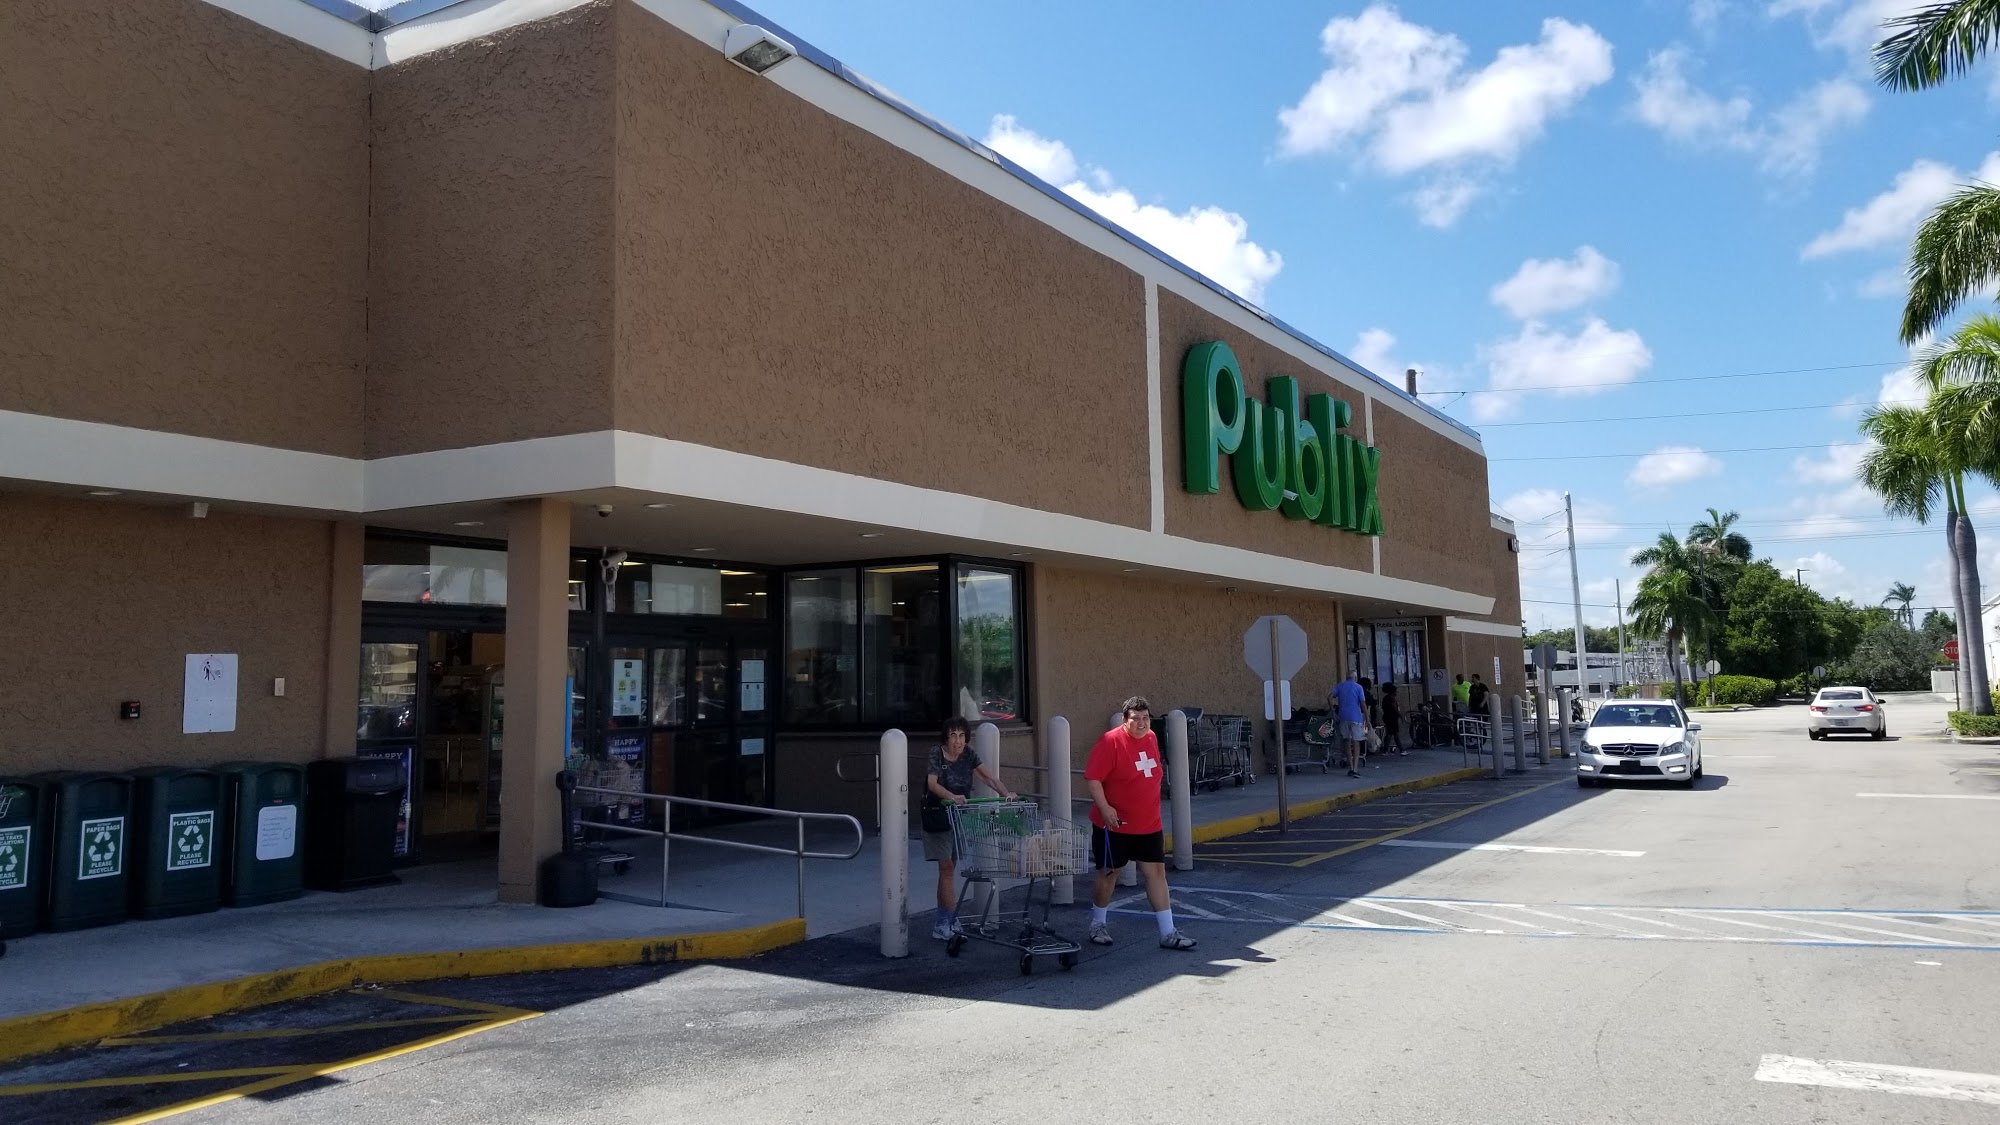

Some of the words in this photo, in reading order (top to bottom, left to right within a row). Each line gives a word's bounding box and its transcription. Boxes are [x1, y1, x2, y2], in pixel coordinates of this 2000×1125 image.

[1183, 340, 1386, 536] Publix
[179, 852, 202, 860] PLEASE
[91, 860, 112, 868] PLEASE
[89, 866, 114, 874] RECYCLE
